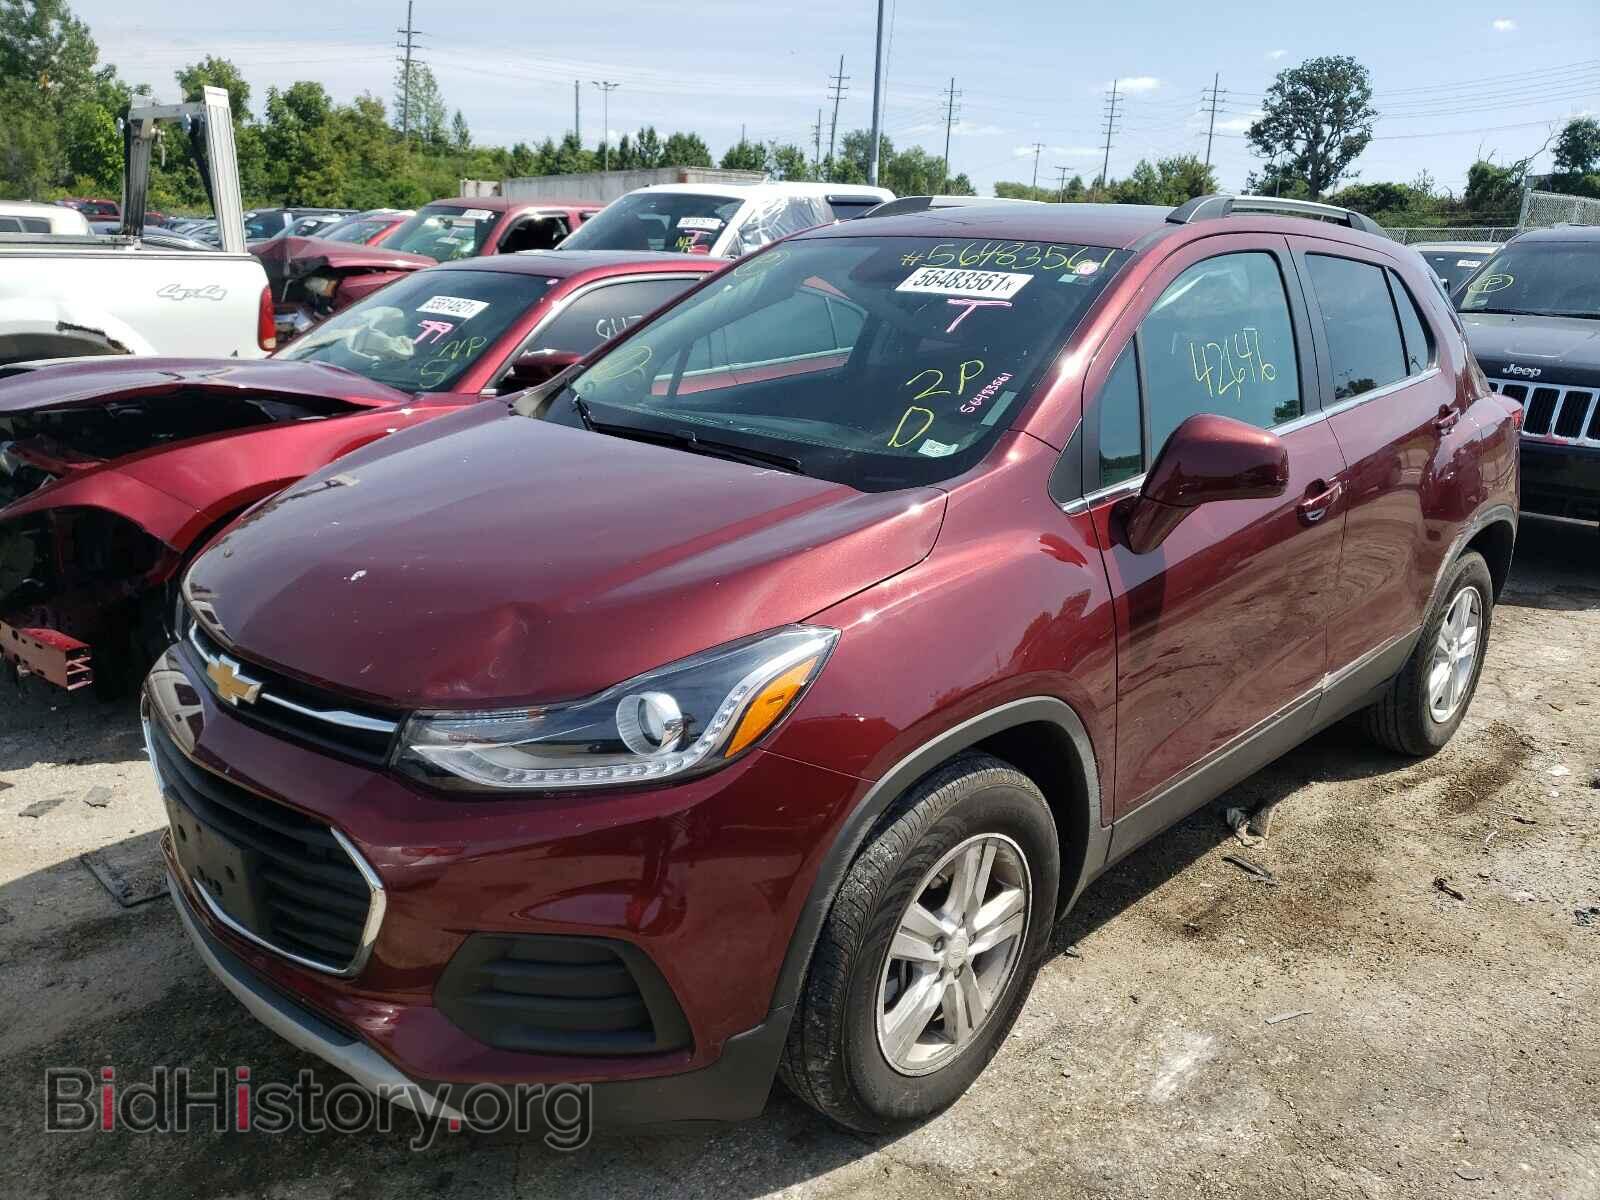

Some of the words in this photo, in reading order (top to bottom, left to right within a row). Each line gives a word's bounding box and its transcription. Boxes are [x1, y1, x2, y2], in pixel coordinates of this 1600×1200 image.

[156, 283, 228, 301] 4x4
[1502, 363, 1542, 378] Jeep
[887, 405, 935, 448] D
